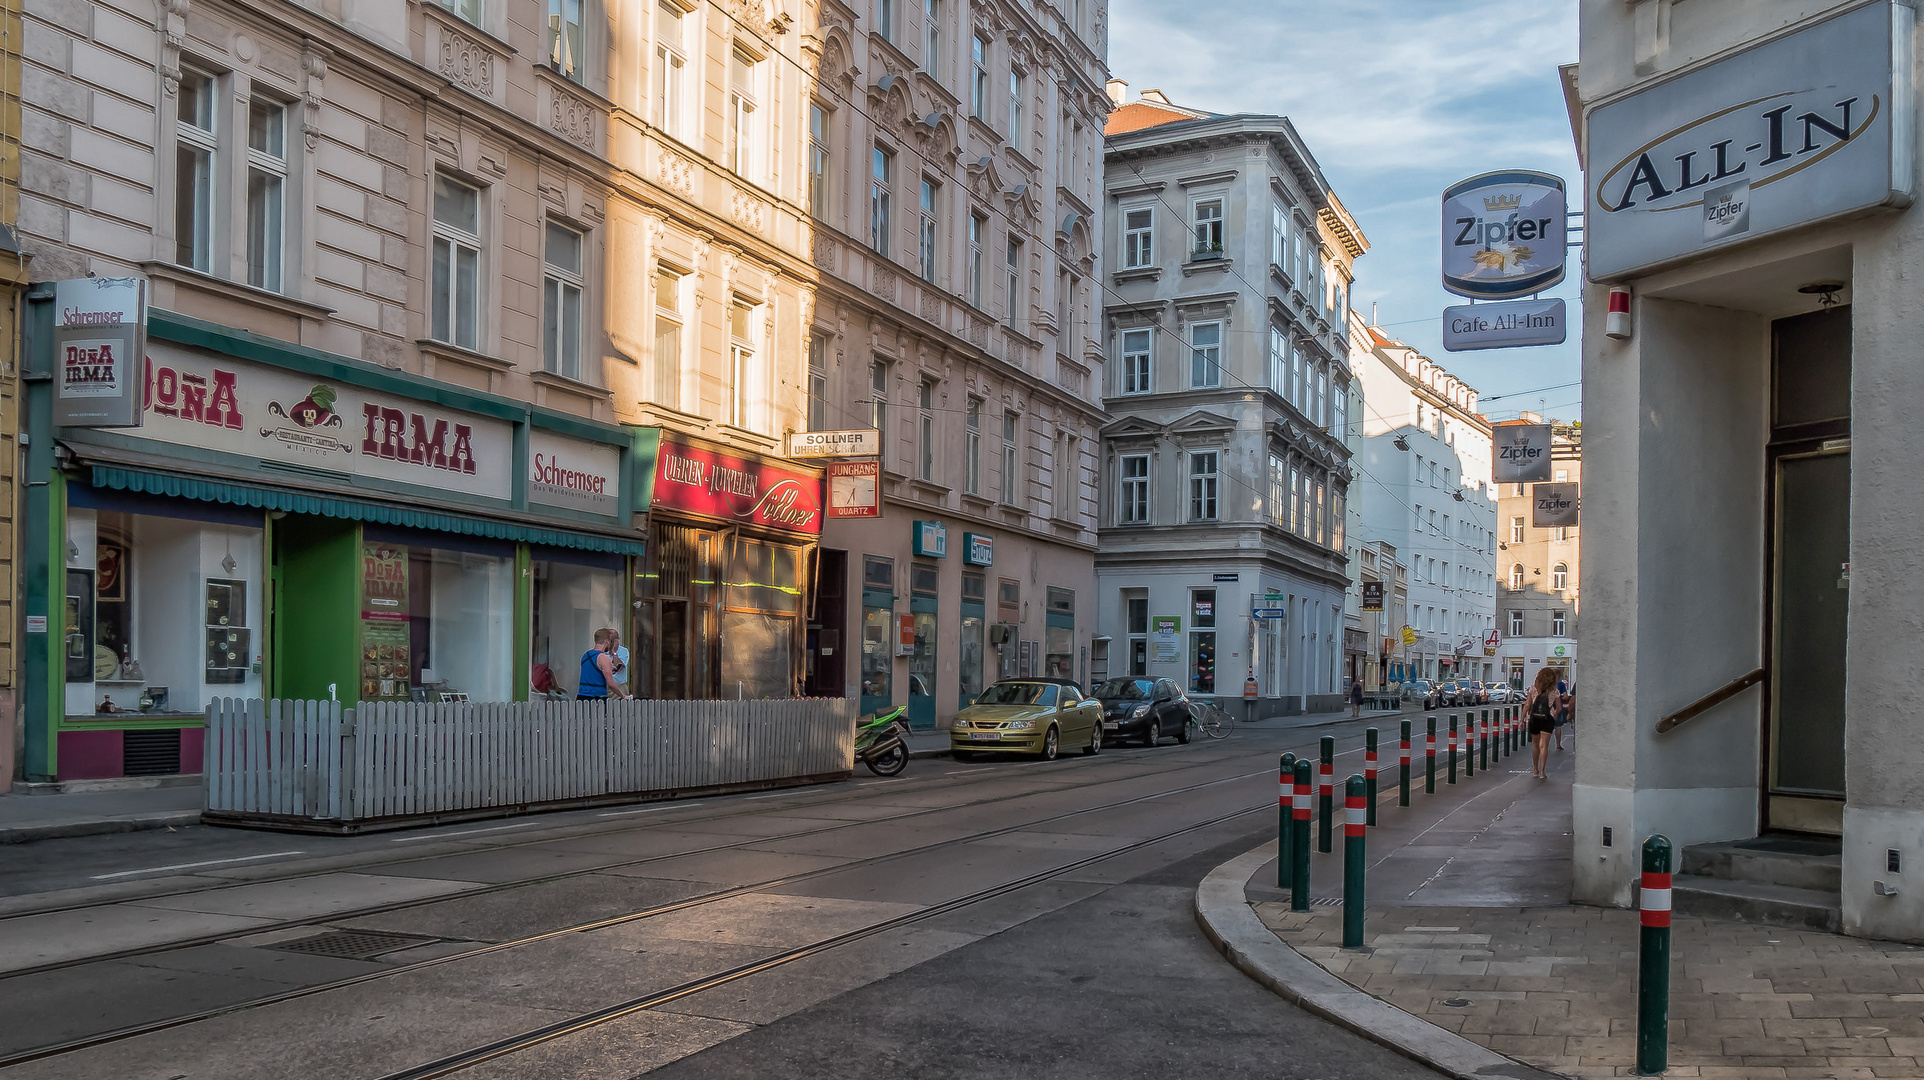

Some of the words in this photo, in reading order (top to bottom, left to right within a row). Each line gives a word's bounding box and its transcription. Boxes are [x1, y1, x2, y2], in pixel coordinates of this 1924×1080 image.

[1612, 97, 1859, 212] ALL-IN
[1708, 202, 1743, 220] Zipfer
[1454, 213, 1552, 251] Zipfer
[63, 306, 124, 325] Schremser
[1451, 318, 1488, 334] Cafe
[1493, 313, 1556, 331] All-Inn
[65, 366, 116, 384] IRMA
[144, 354, 244, 431] OÑA
[361, 401, 477, 475] IRMA
[794, 445, 825, 455] UHREN
[1500, 445, 1542, 461] Zipfer
[533, 453, 606, 494] Schremser
[663, 453, 705, 487] UHREN
[831, 463, 876, 476] JUNGHANS
[533, 484, 546, 492] Das
[838, 506, 868, 516] QUARTZ
[1538, 499, 1571, 510] Zipfer
[364, 579, 406, 600] IRMA
